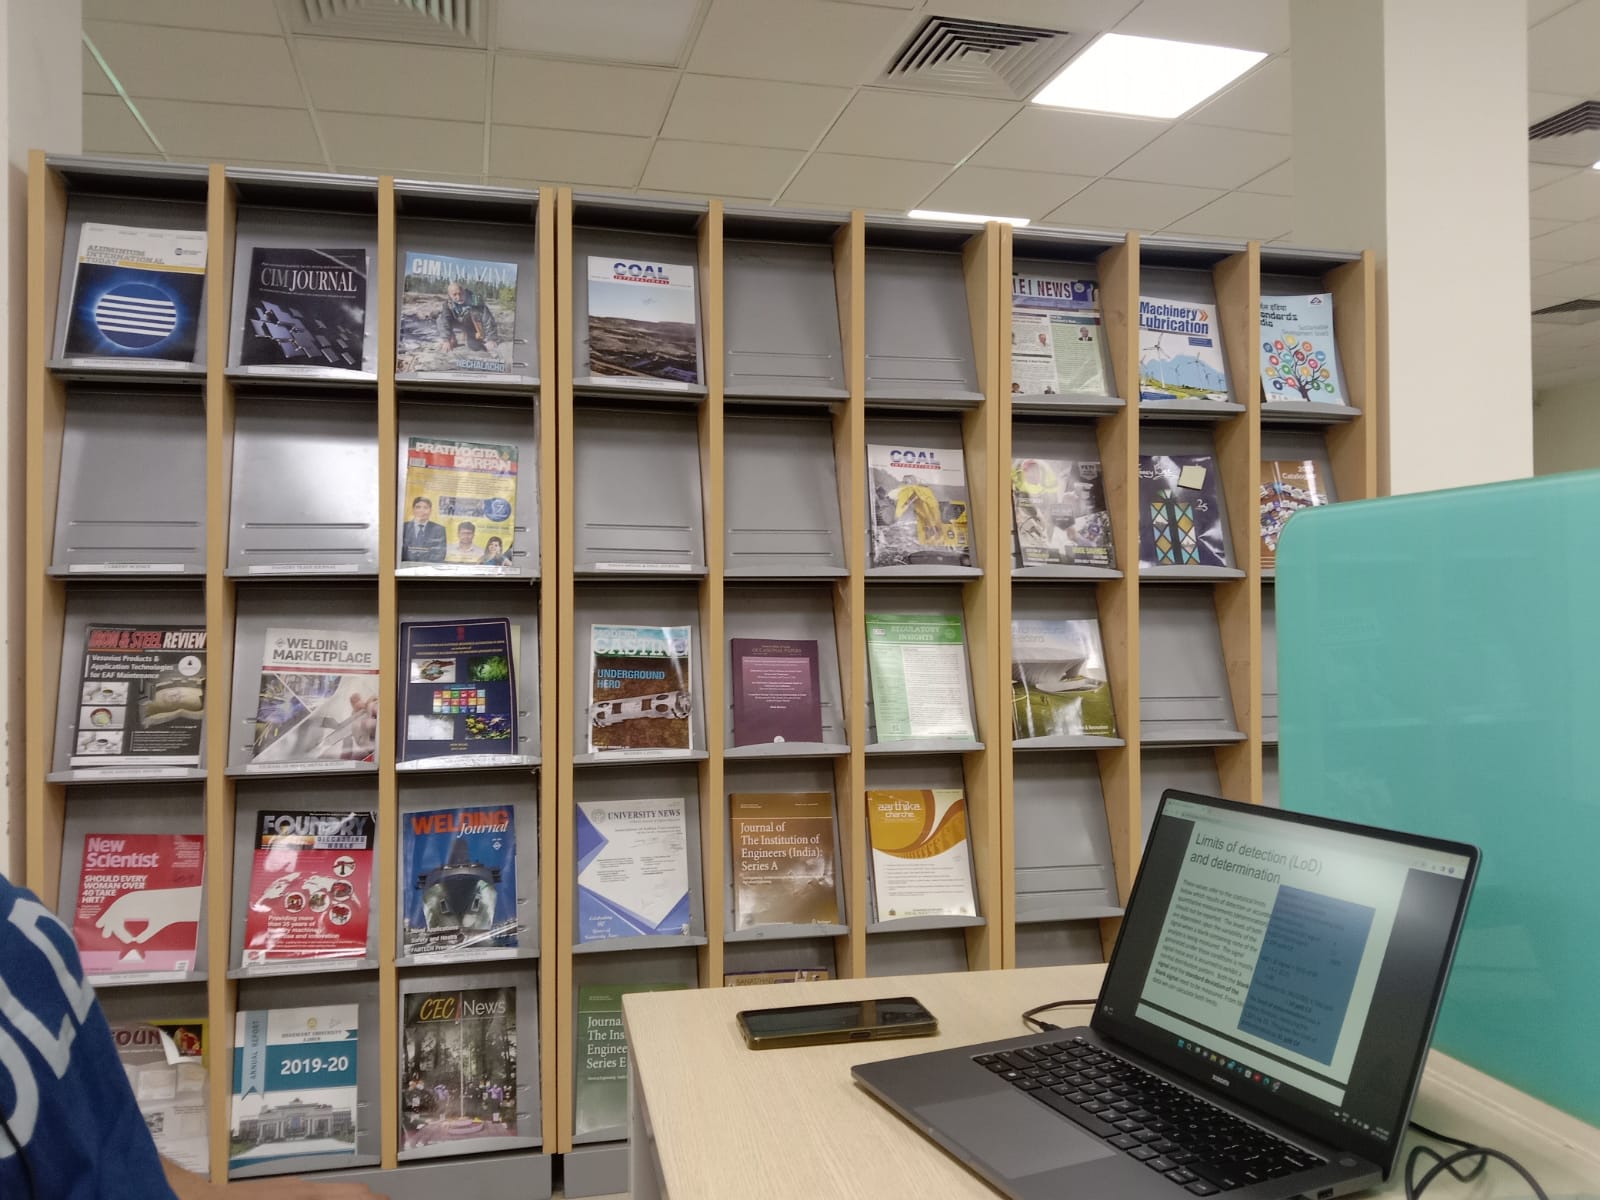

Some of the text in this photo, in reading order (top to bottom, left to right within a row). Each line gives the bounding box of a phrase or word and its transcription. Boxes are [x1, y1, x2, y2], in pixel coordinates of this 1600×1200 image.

[412, 258, 441, 276] CIM
[613, 262, 669, 279] COAL
[260, 267, 357, 292] CIM JOURNAL
[1037, 280, 1071, 298] NEWS
[1139, 301, 1198, 321] Machinery
[1139, 313, 1209, 335] Lubrication
[890, 450, 941, 465] COAL
[130, 630, 162, 649] STEEL
[162, 632, 207, 649] REVIEW
[287, 638, 348, 651] WELDING
[272, 649, 372, 664] MARKETPLACE
[91, 663, 174, 672] Application Technologies
[597, 669, 665, 680] UNDERGROUND
[597, 679, 621, 689] HERO
[411, 809, 509, 835] WELDING
[607, 808, 681, 821] UNIVERSITY NEWS
[263, 815, 369, 836] FOUNDRY
[457, 820, 509, 838] Journal
[740, 821, 787, 834] Journal of
[88, 837, 126, 852] New
[740, 833, 821, 846] The Institution of
[85, 852, 159, 868] Scientist
[741, 846, 824, 860] Engineers (India):
[1194, 833, 1323, 876] Limits of detection (LoD)
[741, 861, 779, 872] Series A
[1189, 851, 1281, 884] and determination
[95, 889, 117, 897] TAKE
[419, 997, 506, 1020] CEC News
[587, 1016, 623, 1029] Journa
[587, 1030, 625, 1040] The Ins
[587, 1044, 628, 1057] Enginee
[280, 1056, 349, 1075] 2019-20
[586, 1058, 617, 1069] Series
